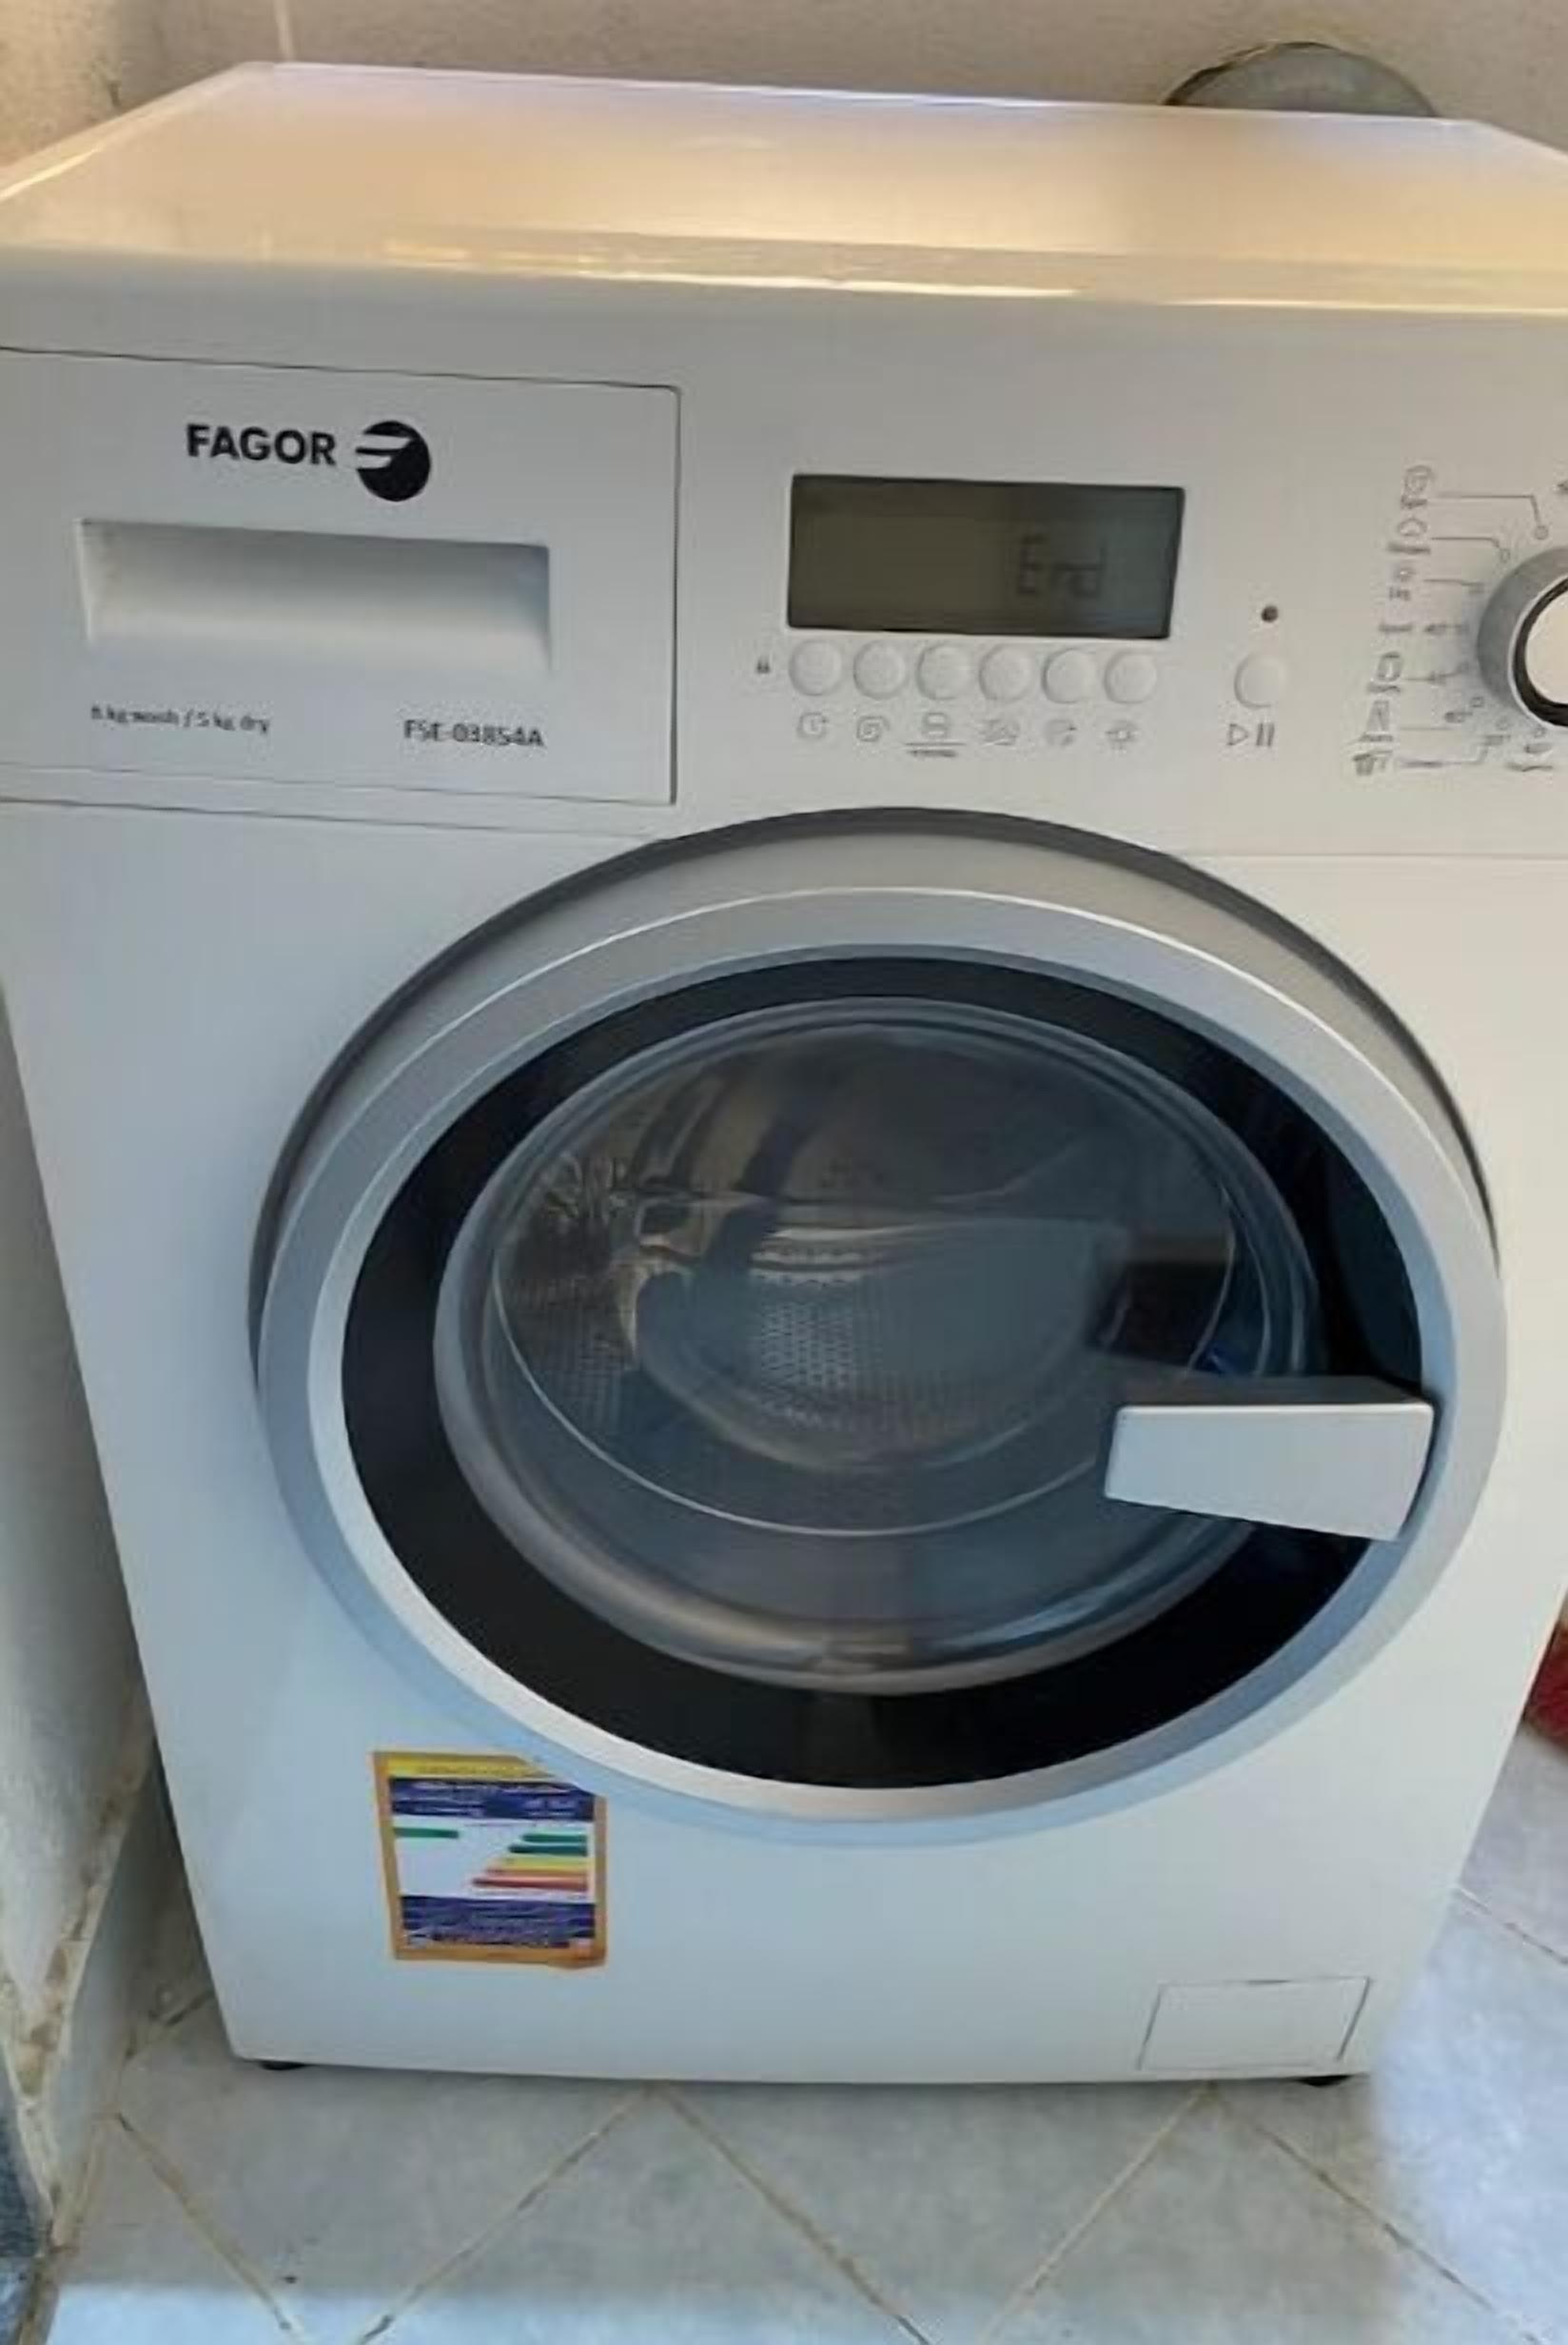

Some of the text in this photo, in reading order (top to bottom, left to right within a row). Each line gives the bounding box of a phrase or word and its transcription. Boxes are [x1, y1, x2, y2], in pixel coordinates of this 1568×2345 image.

[186, 423, 337, 465] FAGOR
[1016, 533, 1107, 599] End
[240, 714, 271, 736] dry
